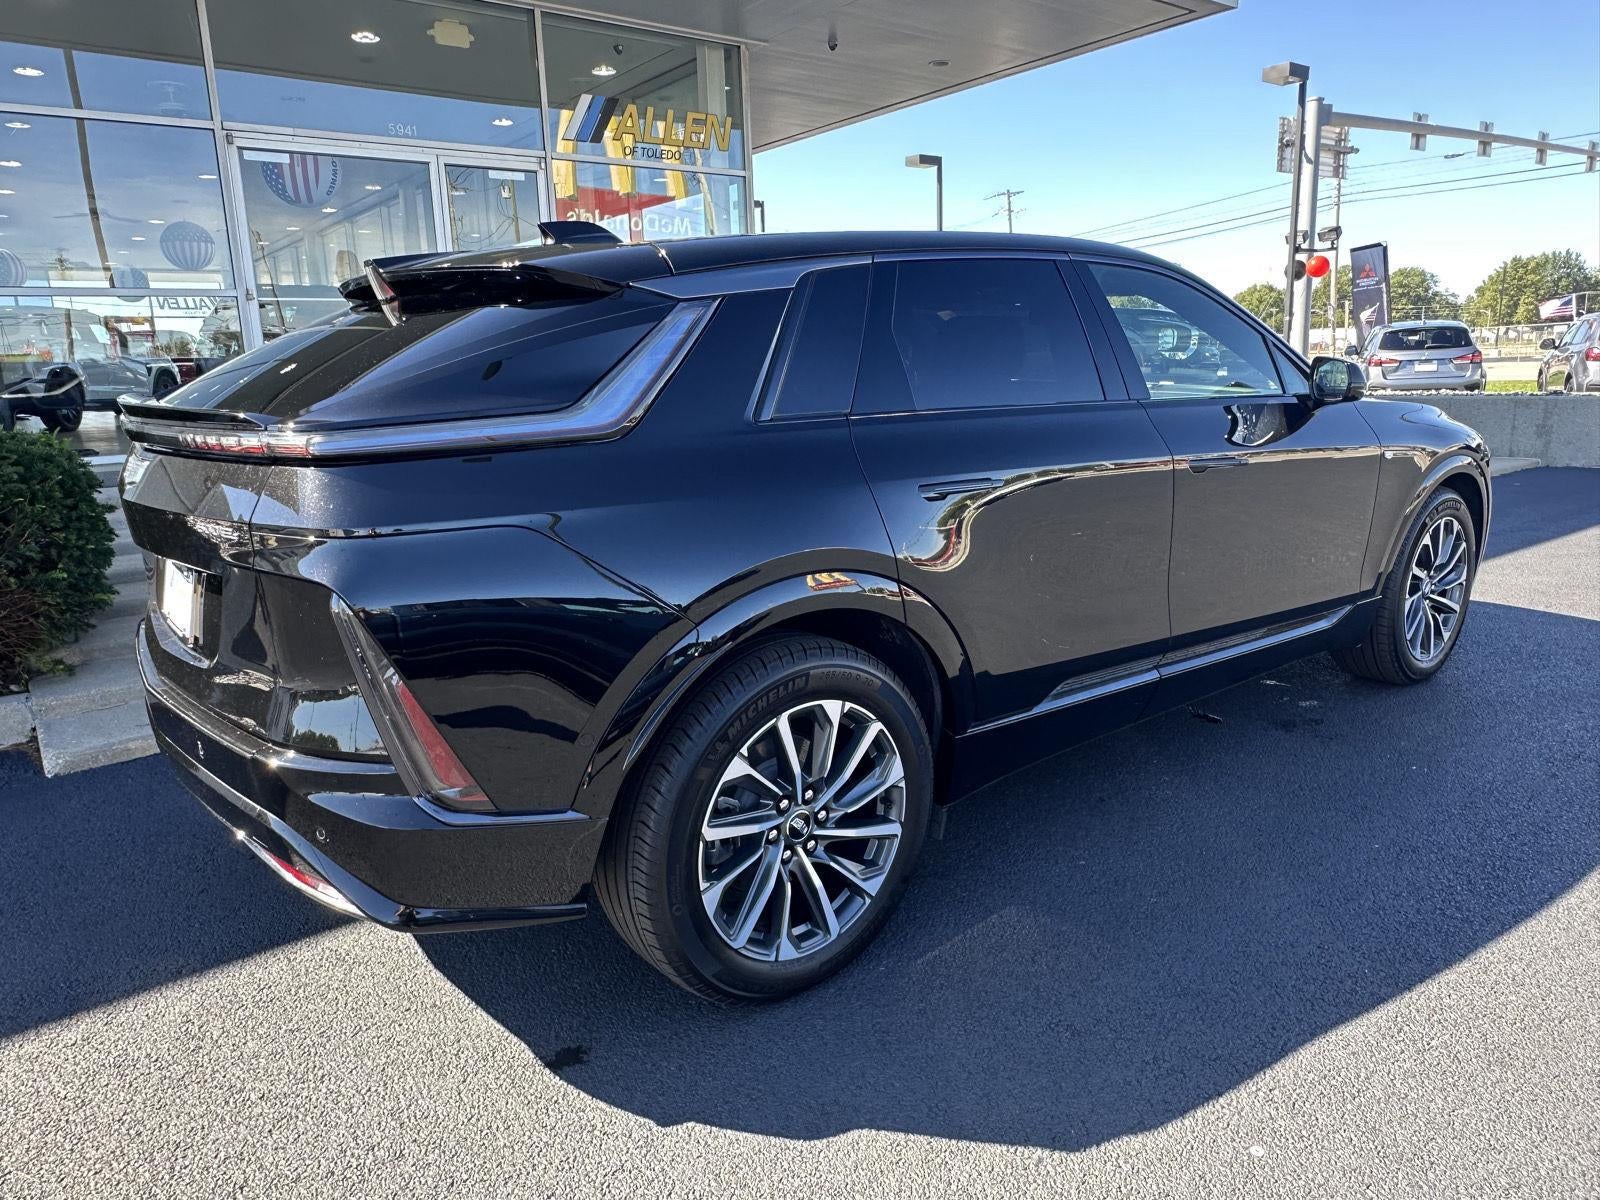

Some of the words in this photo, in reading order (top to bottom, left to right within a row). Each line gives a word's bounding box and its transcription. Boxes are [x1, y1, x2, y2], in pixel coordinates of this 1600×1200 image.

[388, 122, 417, 137] 5941
[612, 103, 732, 152] ALLEN
[623, 145, 640, 157] OF
[641, 147, 682, 160] TOLEDO
[727, 674, 807, 739] MICHELIN
